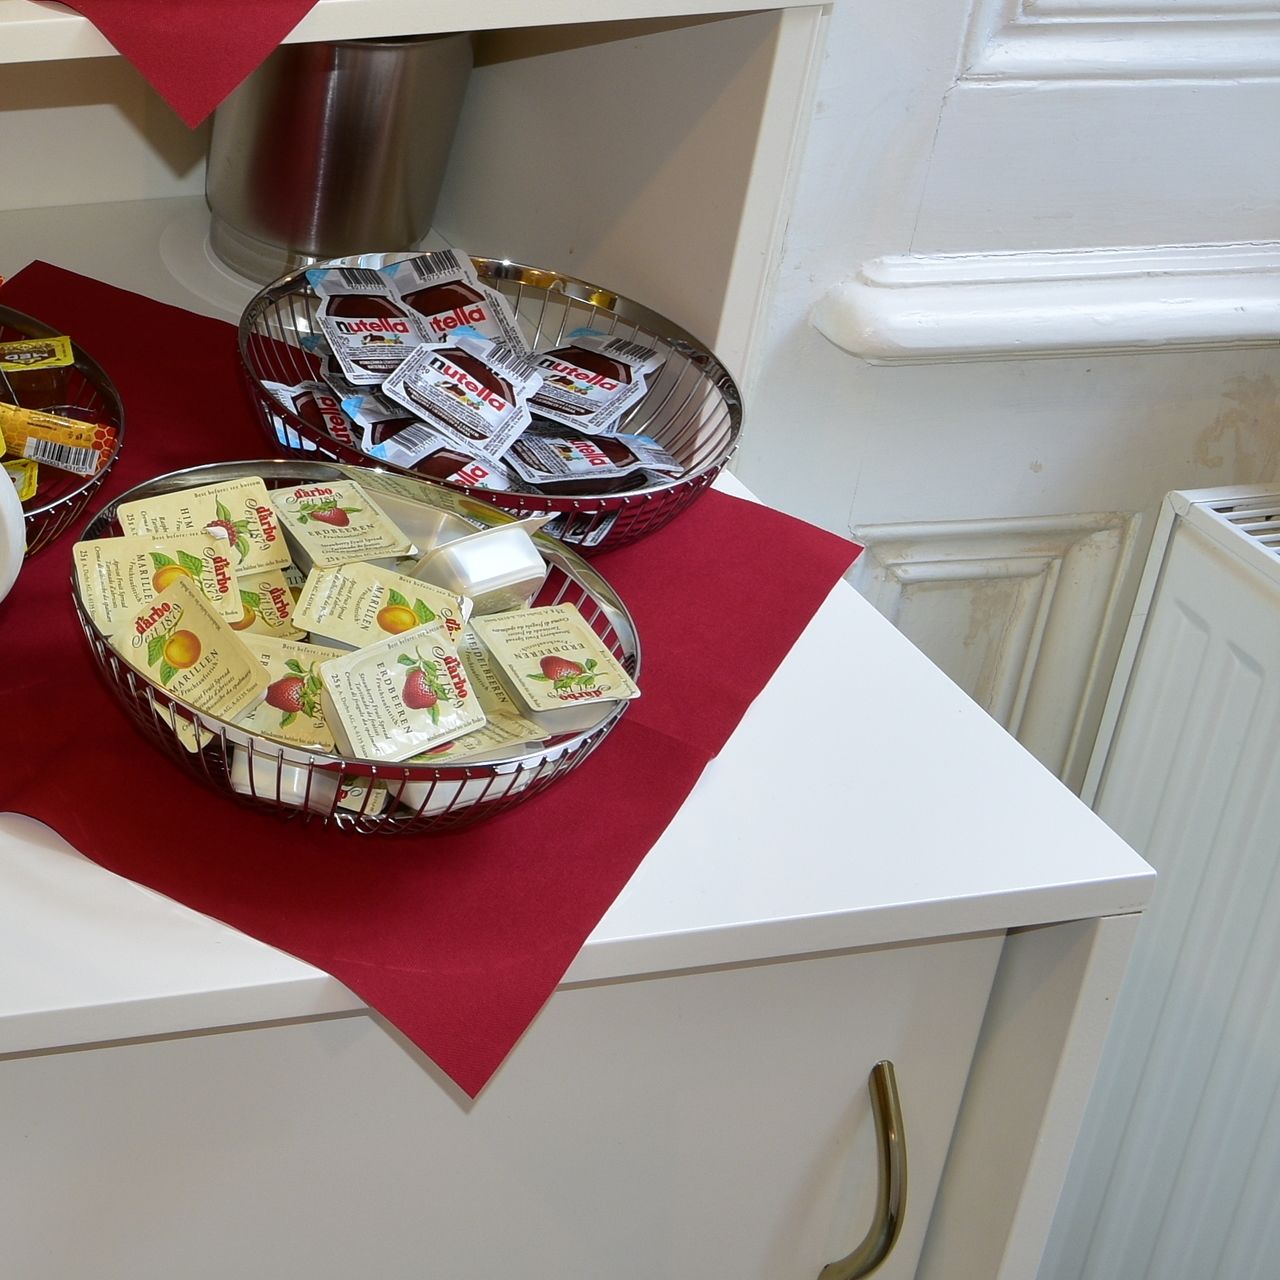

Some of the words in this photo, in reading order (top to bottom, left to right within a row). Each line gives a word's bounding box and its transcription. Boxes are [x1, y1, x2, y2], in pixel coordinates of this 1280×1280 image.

[336, 317, 409, 334] nutella
[429, 305, 486, 334] tella
[5, 352, 48, 360] MED
[429, 357, 506, 412] nutella
[539, 358, 618, 391] nutella
[320, 396, 352, 445] utella
[569, 438, 608, 466] utella
[308, 524, 375, 536] ERDBEEREN
[137, 554, 153, 604] MARILLE
[360, 585, 384, 631] MARILLEN
[466, 633, 508, 703] HEIDELBEEREN
[514, 643, 585, 660] ERDBEEREN
[169, 649, 219, 694] MARILLEN
[329, 673, 340, 684] 25
[376, 662, 413, 734] ERDBEEREN
